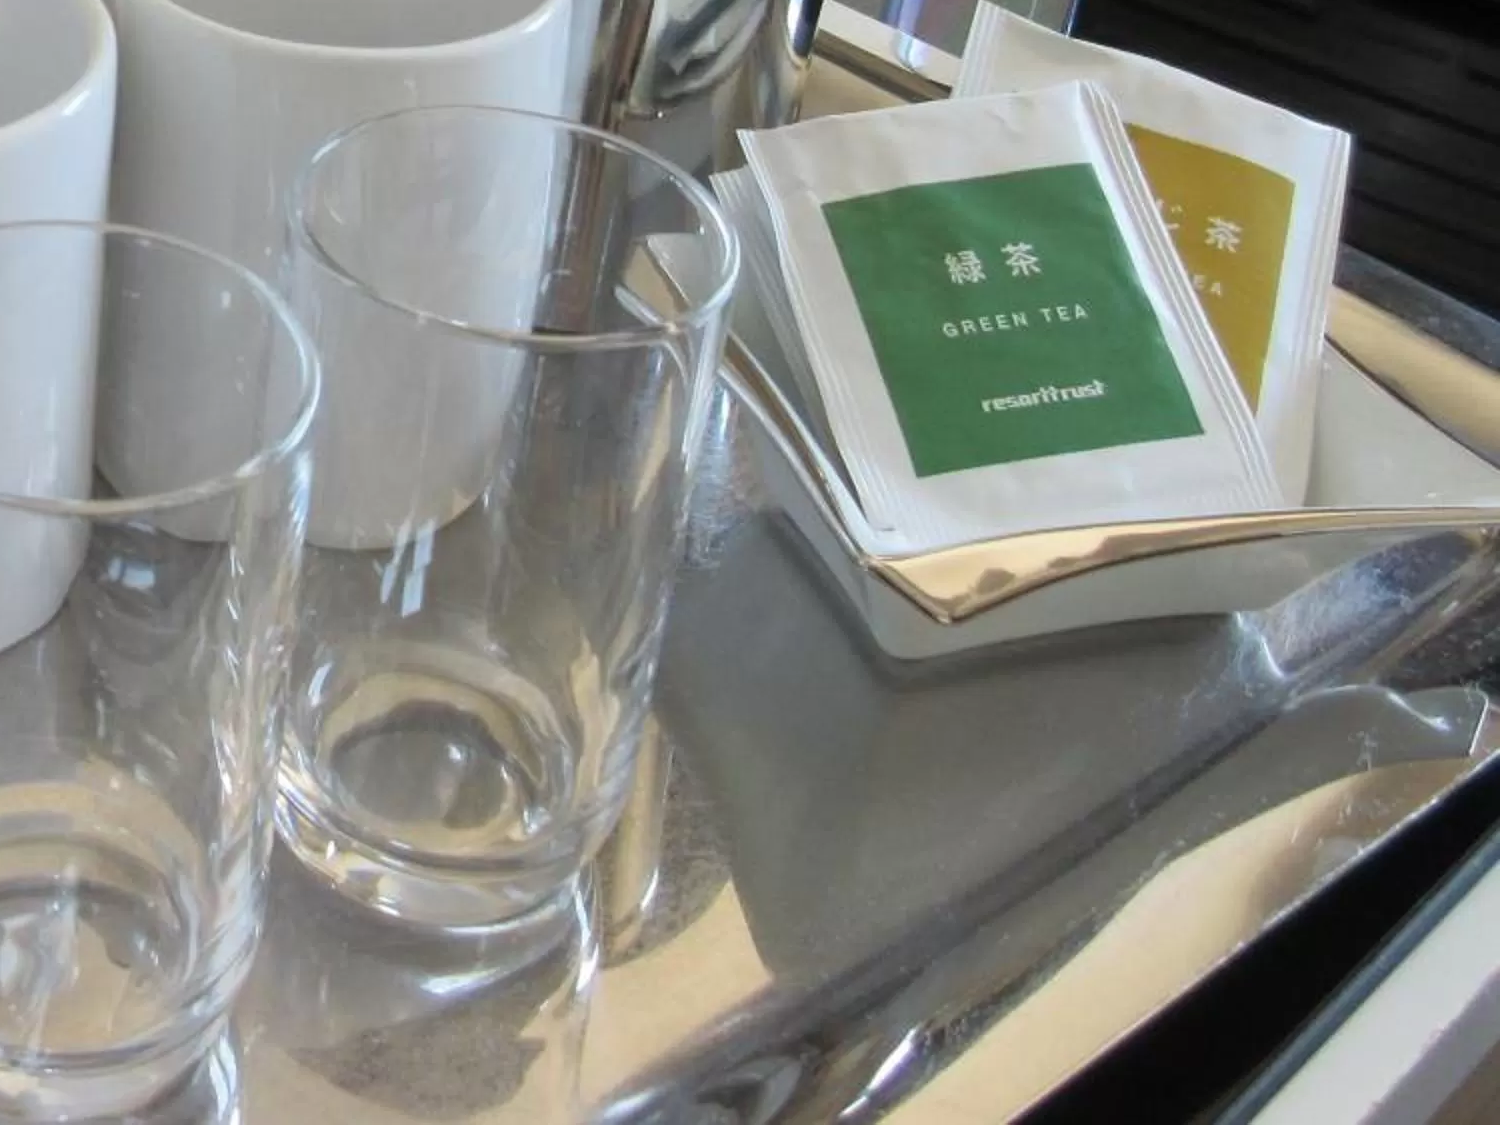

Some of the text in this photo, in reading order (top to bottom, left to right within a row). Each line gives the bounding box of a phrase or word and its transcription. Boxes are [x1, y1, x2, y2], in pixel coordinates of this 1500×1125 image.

[943, 241, 1043, 286] 緑茶
[1191, 273, 1223, 297] EA
[942, 303, 1089, 339] GREEN TEA
